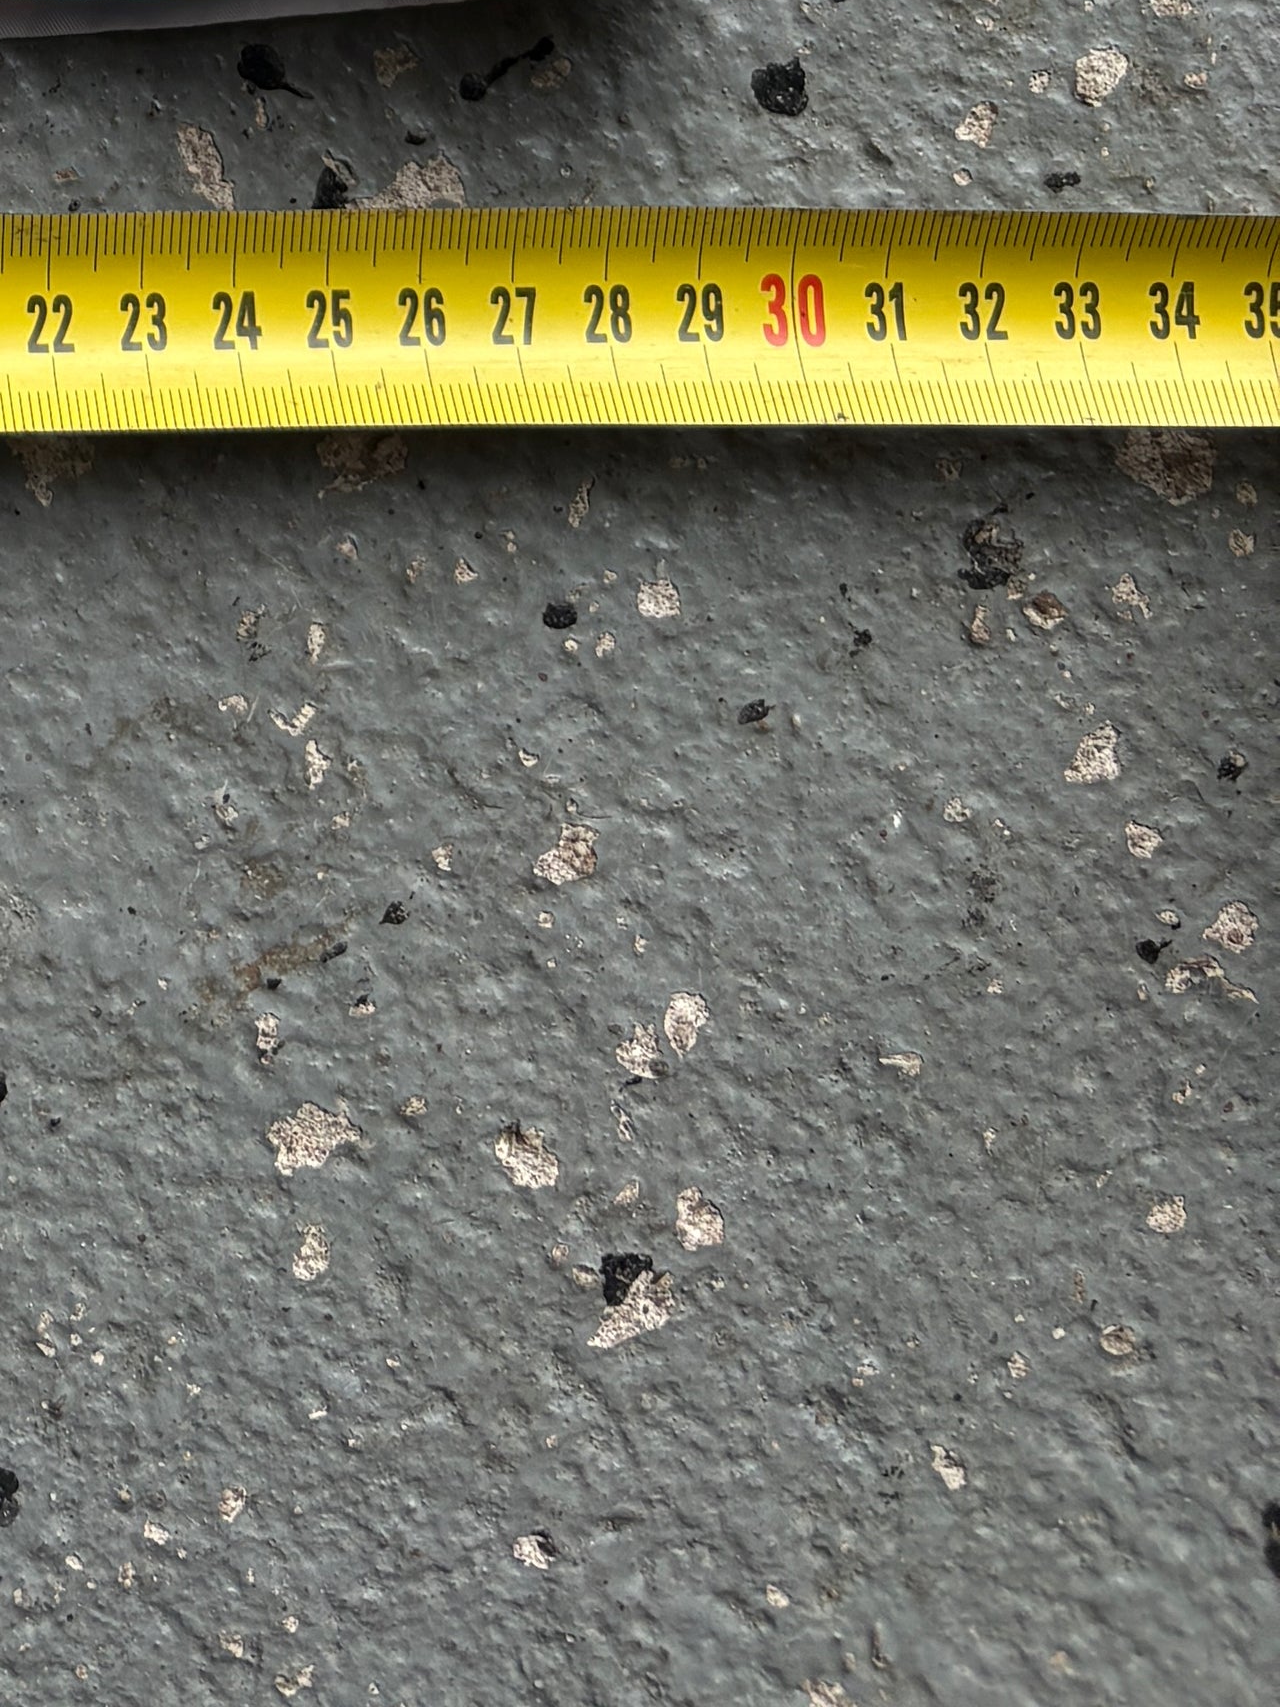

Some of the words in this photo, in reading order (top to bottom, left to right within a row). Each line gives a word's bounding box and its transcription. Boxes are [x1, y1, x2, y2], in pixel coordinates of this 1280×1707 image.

[27, 294, 75, 353] 22
[120, 293, 168, 351] 23
[212, 291, 262, 350] 24
[306, 289, 353, 348] 25
[398, 287, 446, 347] 26
[490, 286, 537, 346] 27
[584, 284, 633, 344] 28
[676, 283, 725, 342] 29
[760, 274, 826, 347] 30
[865, 282, 908, 341] 31
[958, 282, 1009, 340] 32
[1053, 281, 1102, 339] 33
[1148, 281, 1200, 339] 34
